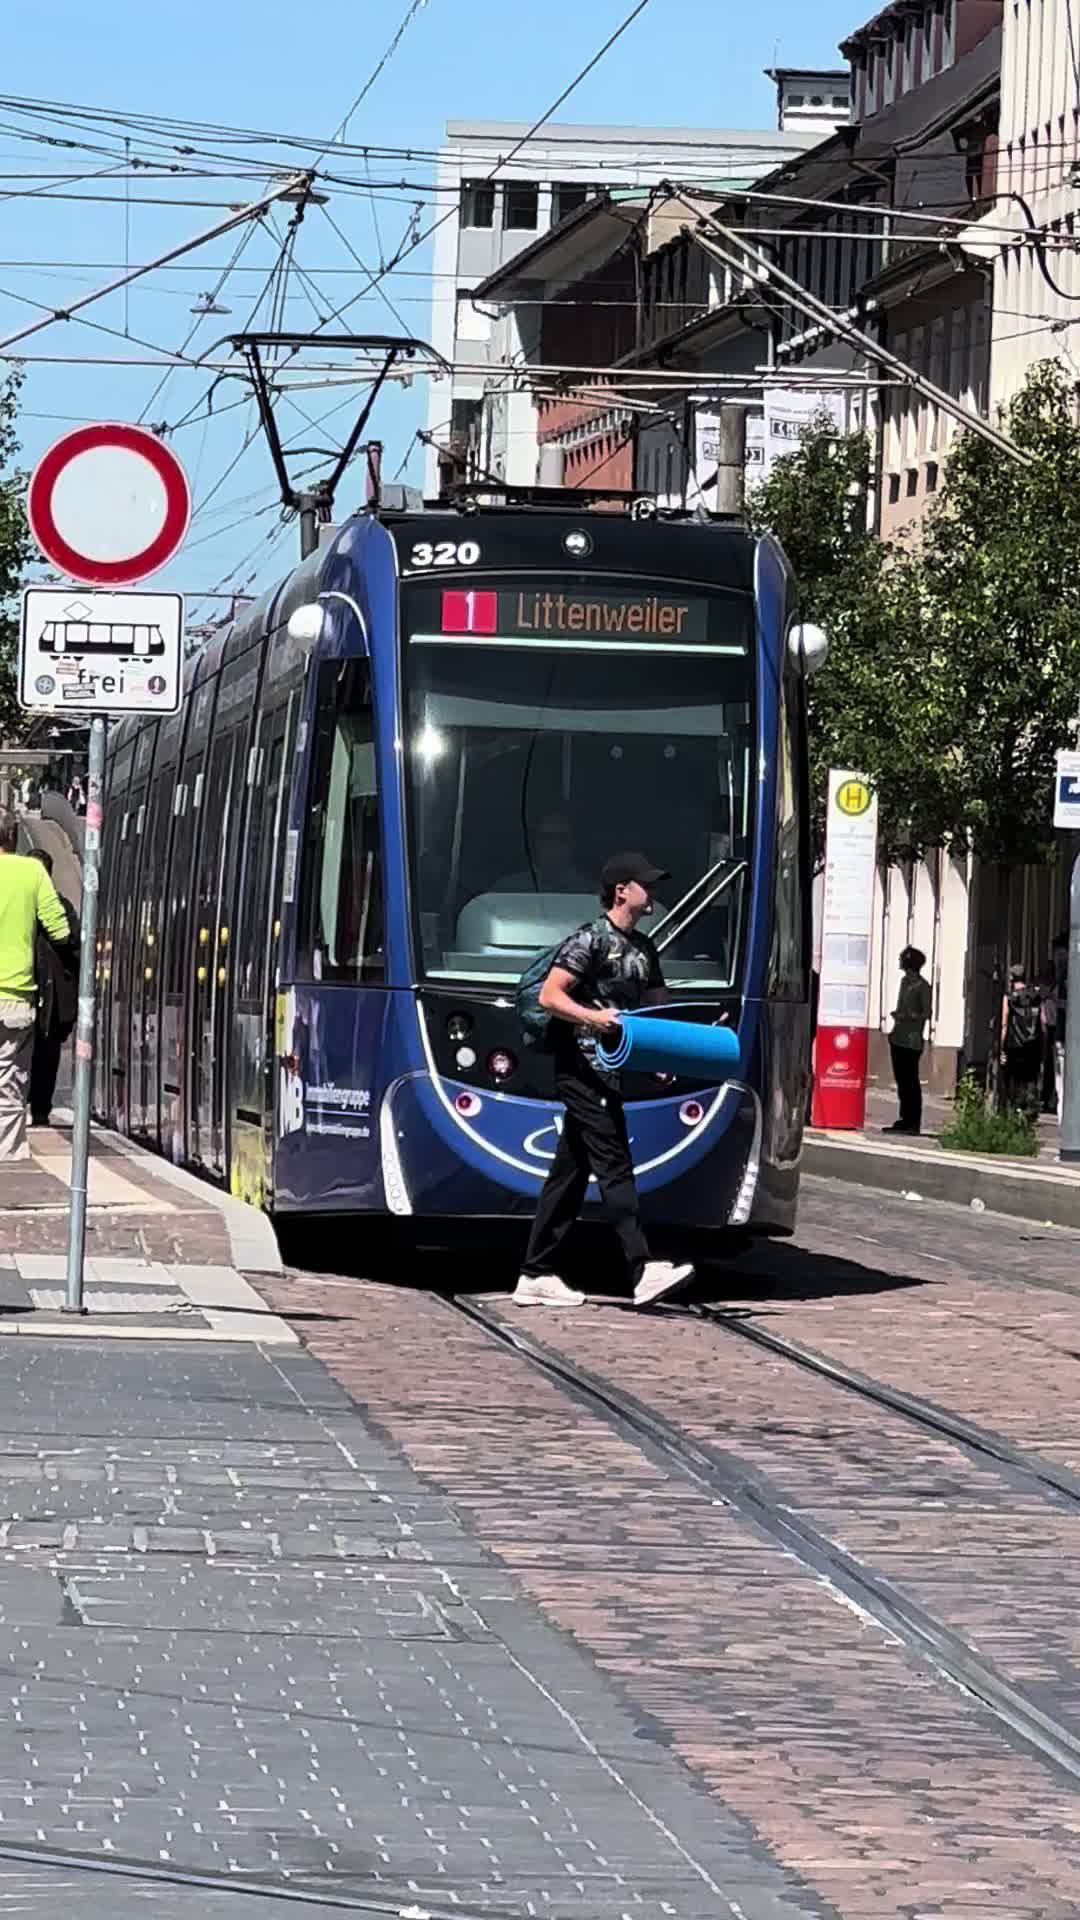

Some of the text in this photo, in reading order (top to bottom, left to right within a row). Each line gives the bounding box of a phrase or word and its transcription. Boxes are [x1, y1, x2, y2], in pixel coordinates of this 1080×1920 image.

[410, 541, 481, 567] 320
[464, 591, 690, 634] 1 Littenweiler
[77, 668, 125, 694] frei
[844, 786, 863, 809] H
